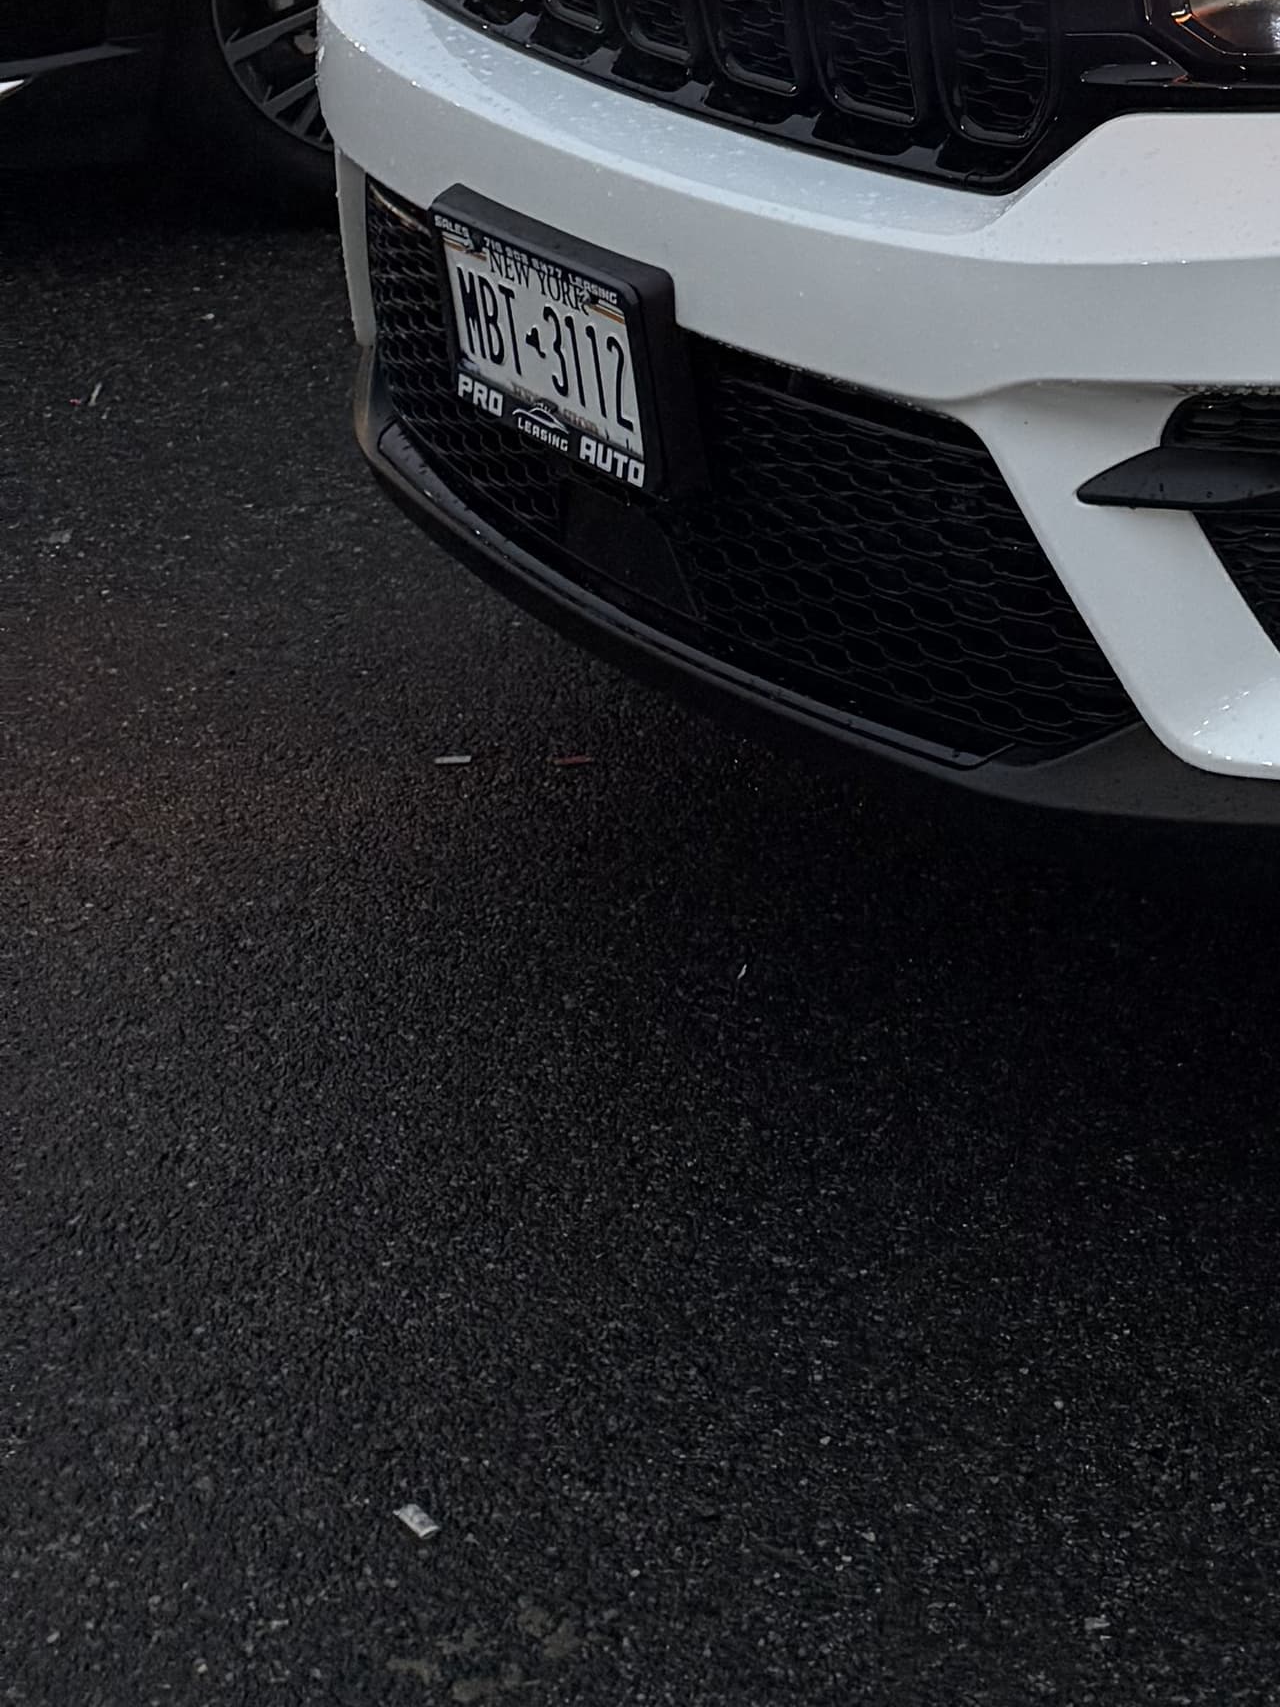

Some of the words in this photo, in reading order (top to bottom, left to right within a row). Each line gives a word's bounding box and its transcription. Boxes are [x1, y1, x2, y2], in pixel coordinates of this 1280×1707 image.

[434, 214, 470, 238] SALES
[485, 247, 530, 290] NEW
[536, 265, 590, 316] YORK
[542, 303, 636, 433] 3112
[456, 372, 504, 418] PRO
[579, 435, 646, 489] AUTO
[516, 416, 569, 453] LEASING
